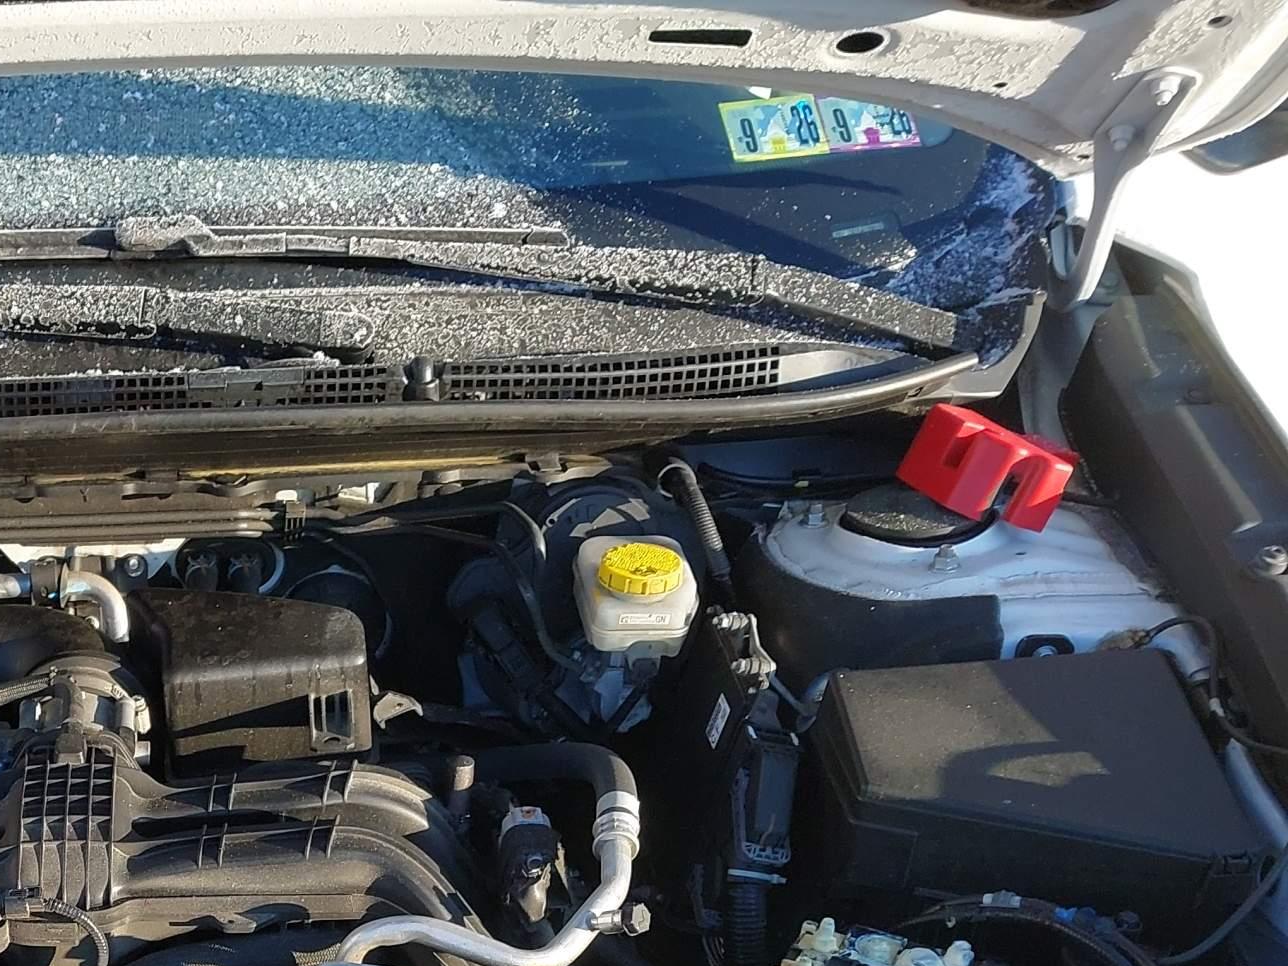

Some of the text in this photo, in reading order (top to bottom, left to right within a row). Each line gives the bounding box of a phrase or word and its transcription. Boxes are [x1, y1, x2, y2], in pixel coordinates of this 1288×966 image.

[739, 104, 820, 153] 9 26
[832, 108, 852, 143] 9
